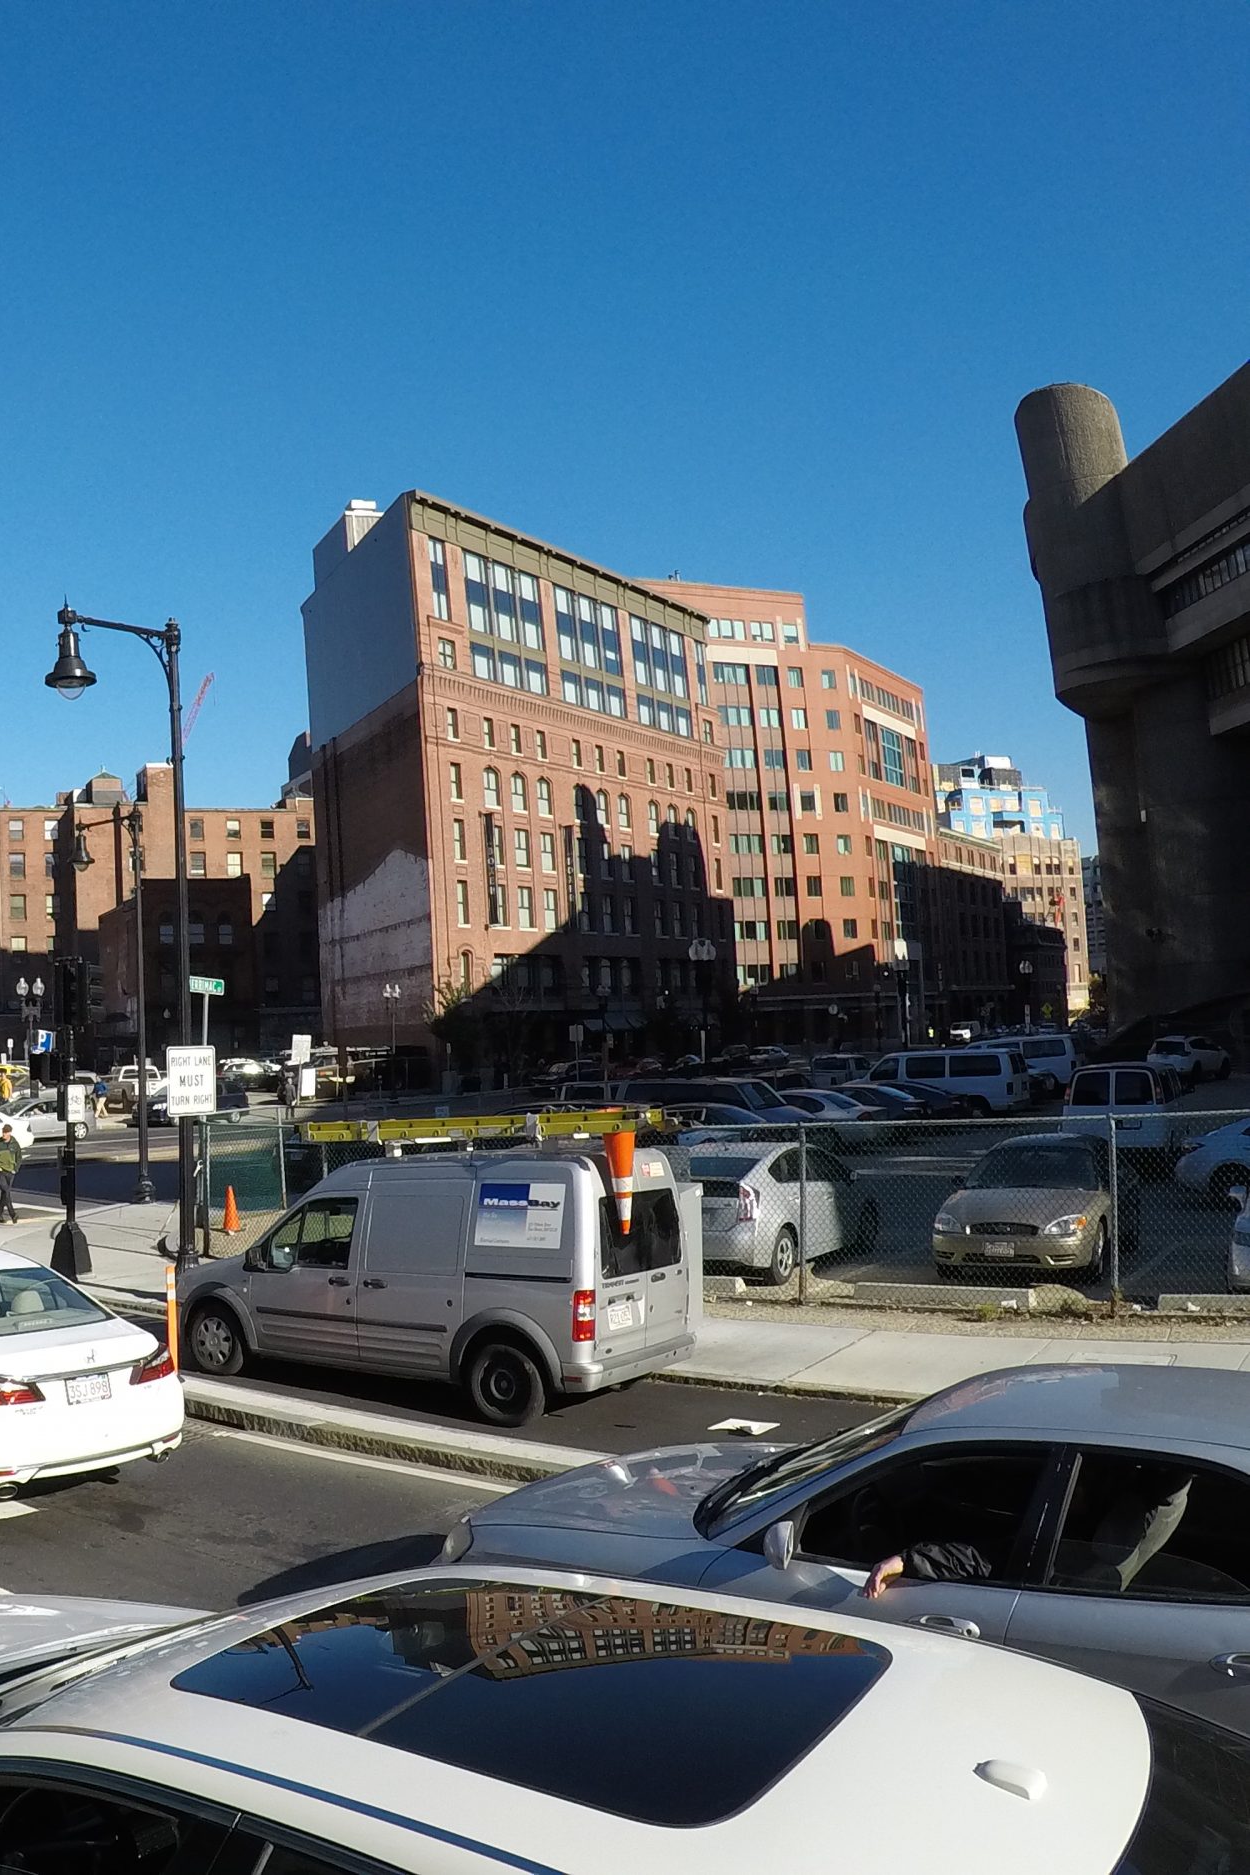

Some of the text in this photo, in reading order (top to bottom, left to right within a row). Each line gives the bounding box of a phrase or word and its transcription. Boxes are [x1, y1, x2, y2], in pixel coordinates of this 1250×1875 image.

[190, 978, 216, 992] ERRIMAC
[171, 1056, 212, 1067] RIGHT LANE
[179, 1074, 204, 1087] MUST
[171, 1093, 212, 1106] TURN RIGHT
[90, 1380, 109, 1396] 898
